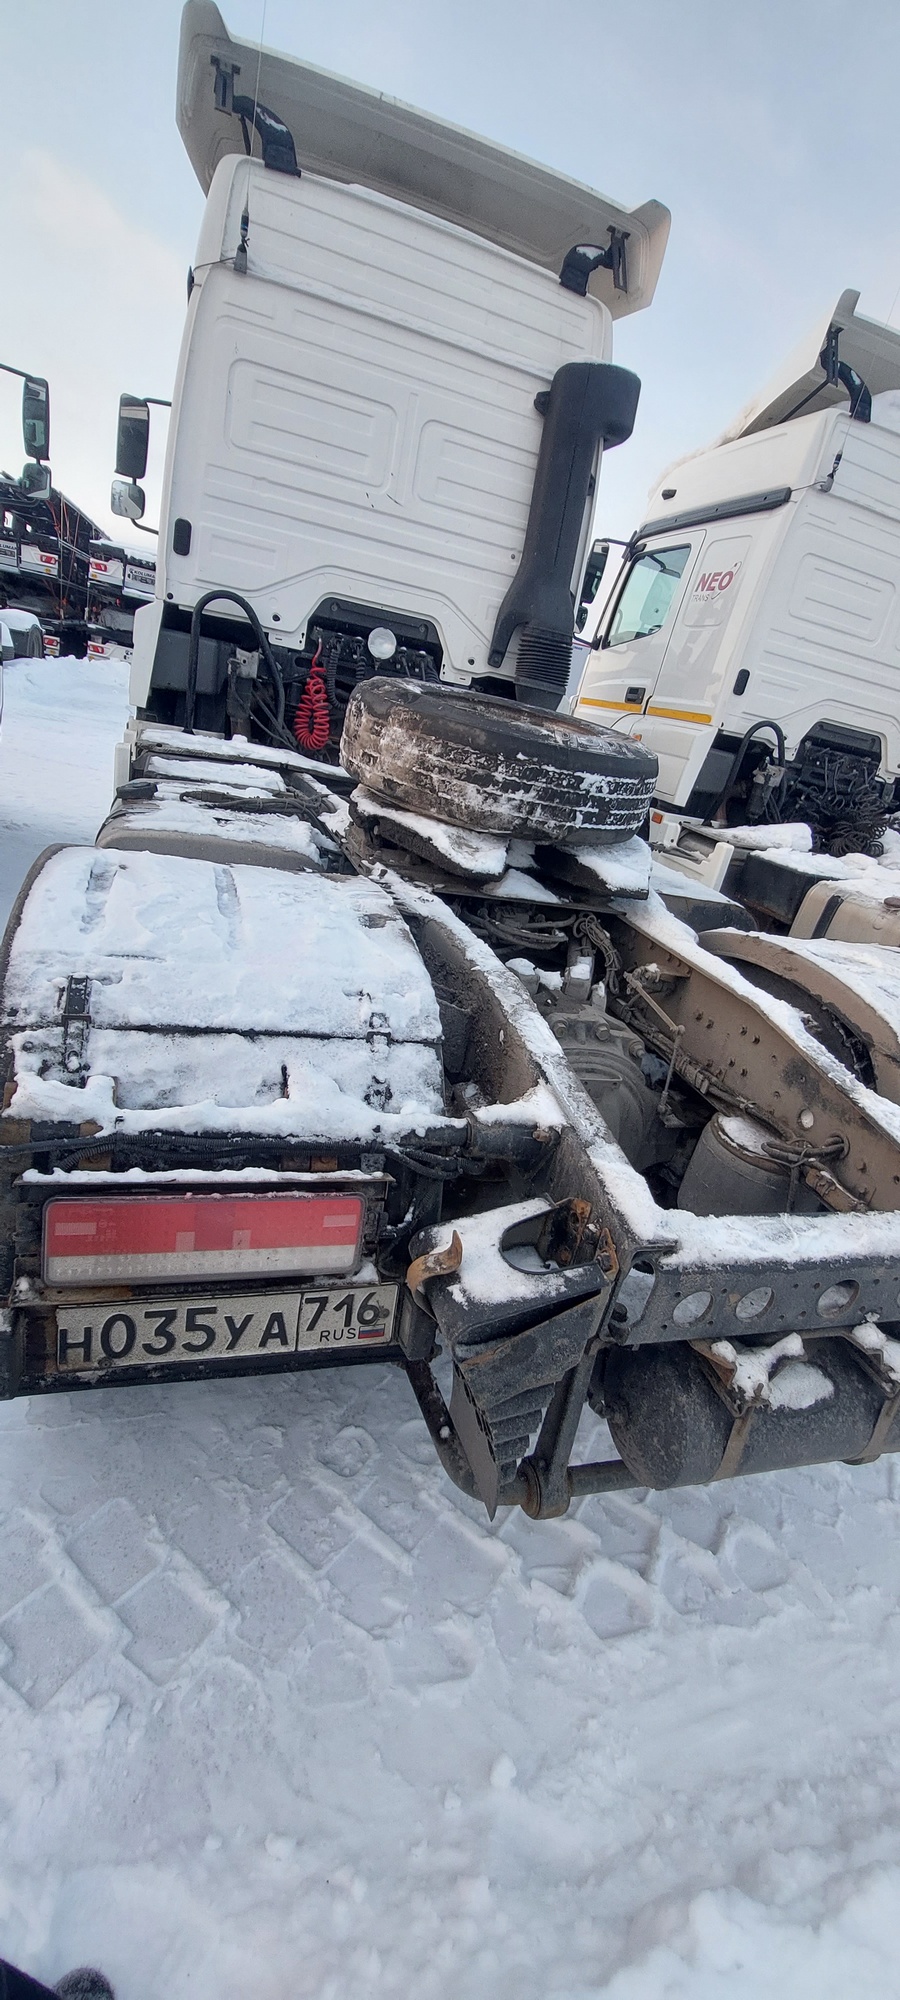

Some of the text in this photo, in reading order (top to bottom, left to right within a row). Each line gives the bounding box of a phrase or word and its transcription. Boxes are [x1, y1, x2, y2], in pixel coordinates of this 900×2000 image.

[695, 571, 734, 592] NEO
[692, 594, 710, 602] TRANS
[304, 1291, 380, 1332] 716
[319, 1326, 357, 1343] RUS
